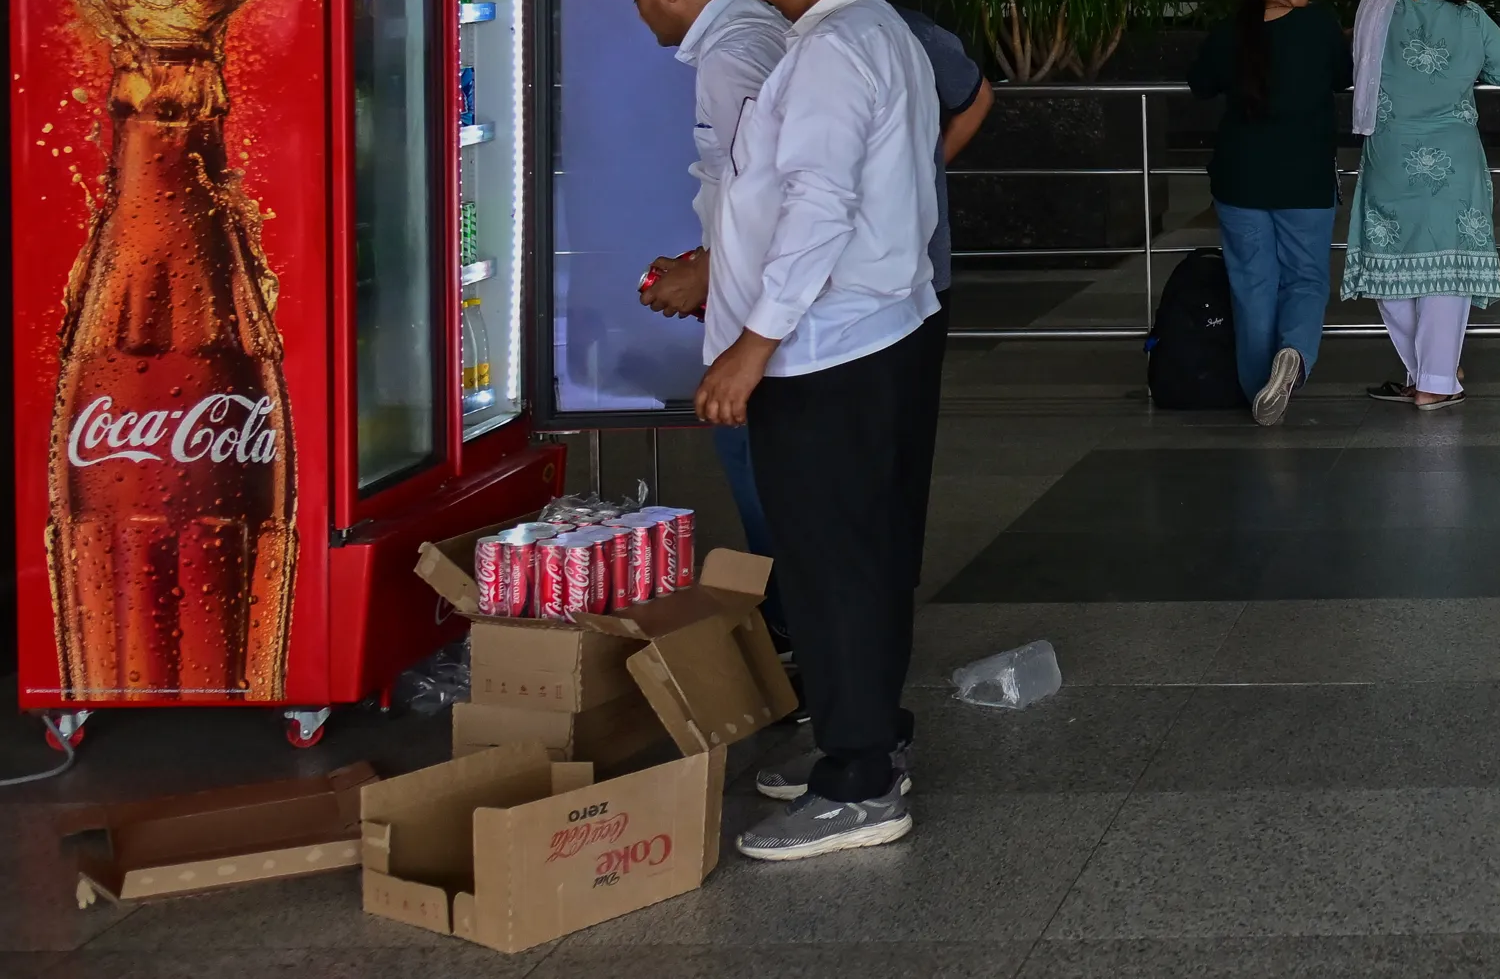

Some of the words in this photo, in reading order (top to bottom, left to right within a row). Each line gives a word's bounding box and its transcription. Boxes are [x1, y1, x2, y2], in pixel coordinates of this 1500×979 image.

[68, 393, 283, 468] Coca-Cola
[568, 801, 609, 823] zero
[545, 812, 629, 863] Coca-Cola
[595, 833, 672, 875] Coke
[592, 871, 621, 889] Diet
